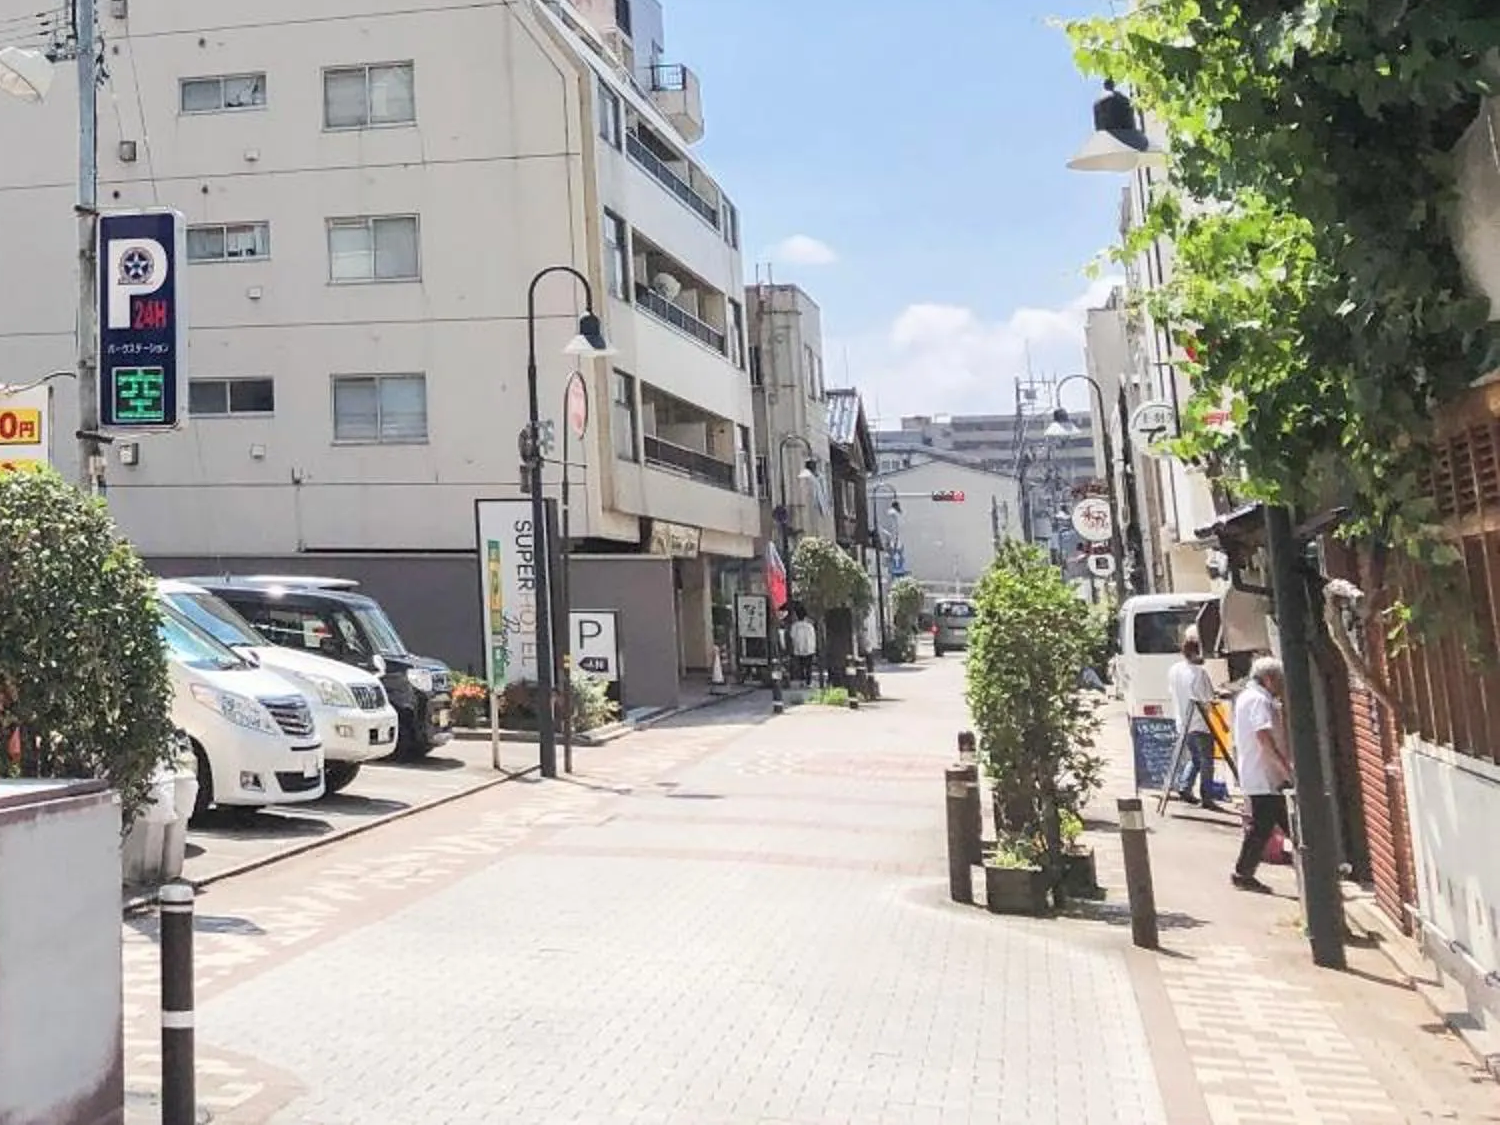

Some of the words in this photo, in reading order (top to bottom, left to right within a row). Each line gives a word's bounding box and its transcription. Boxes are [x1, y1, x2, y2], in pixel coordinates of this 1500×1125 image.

[108, 238, 168, 329] P
[133, 299, 168, 330] 24H
[117, 369, 163, 419] 空
[579, 619, 603, 650] P
